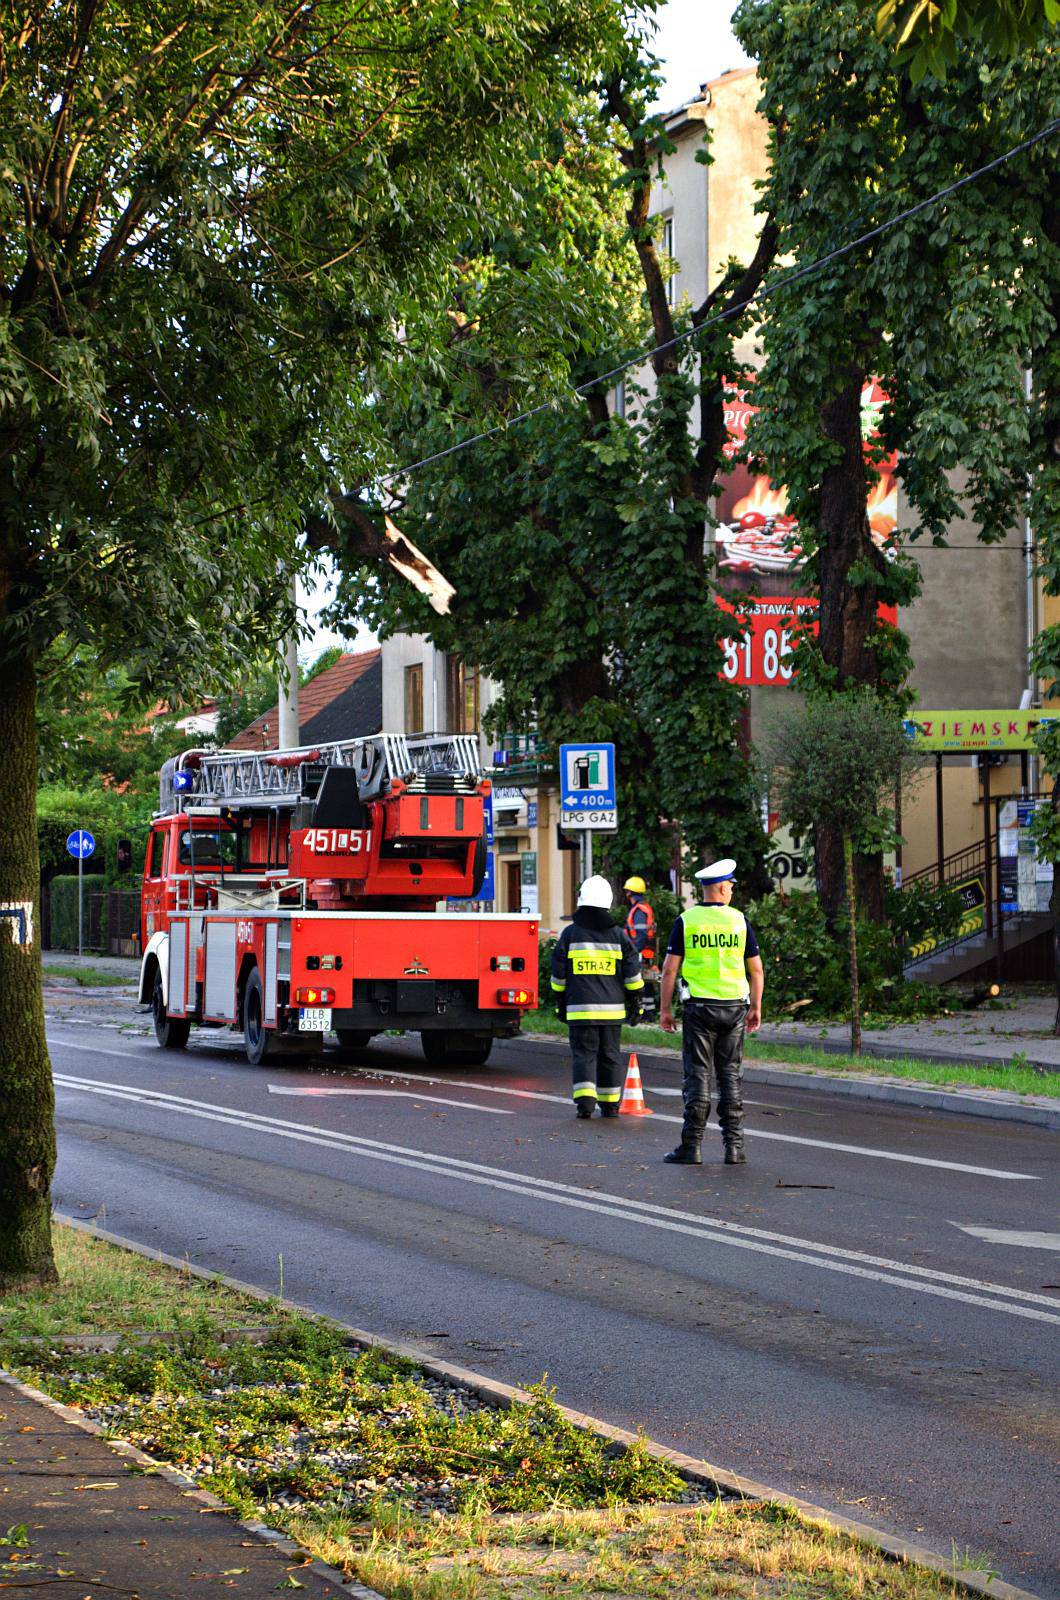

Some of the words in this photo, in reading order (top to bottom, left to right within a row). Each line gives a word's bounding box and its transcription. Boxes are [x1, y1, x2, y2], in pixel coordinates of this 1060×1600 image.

[581, 795, 613, 806] 400m
[562, 812, 584, 823] LPG
[590, 812, 615, 823] GAZ
[692, 934, 739, 948] POLICJA
[306, 1009, 325, 1019] LLB
[300, 1020, 330, 1030] 63512
